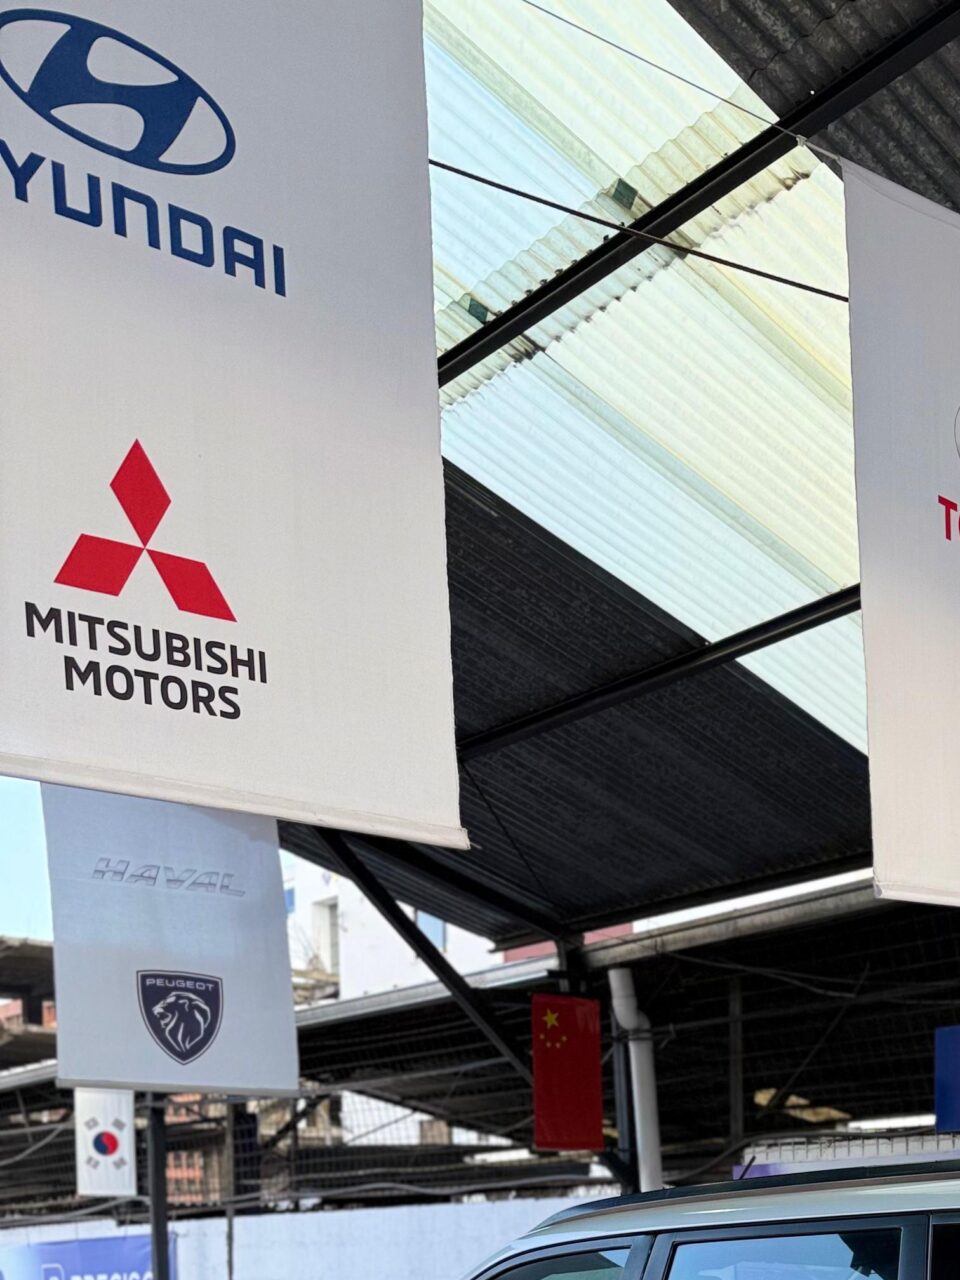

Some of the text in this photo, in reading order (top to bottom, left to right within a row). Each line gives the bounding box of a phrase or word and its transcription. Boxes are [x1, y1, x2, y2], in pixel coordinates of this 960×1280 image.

[0, 139, 286, 298] YUNDAI
[25, 601, 268, 684] MITSUBISHI
[64, 655, 241, 720] MOTORS
[92, 857, 246, 897] HAVAL
[145, 978, 215, 991] PEUGEOT
